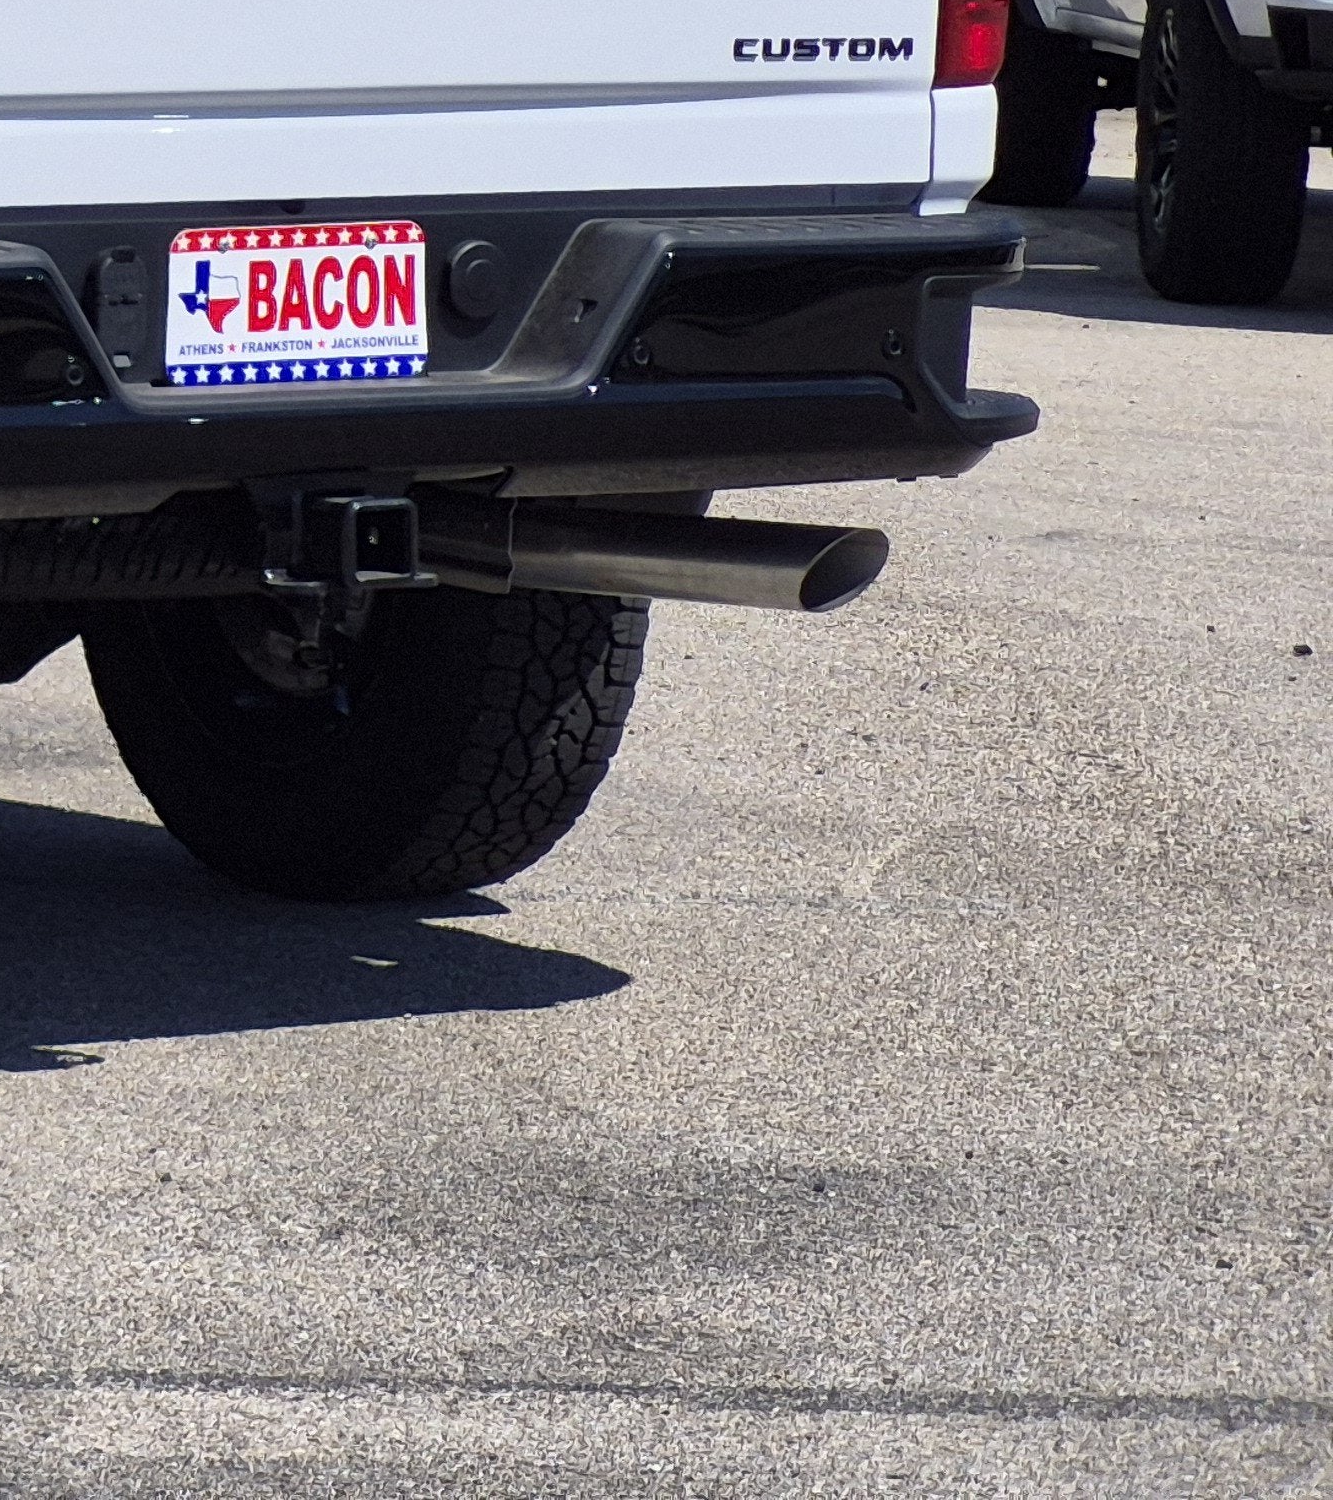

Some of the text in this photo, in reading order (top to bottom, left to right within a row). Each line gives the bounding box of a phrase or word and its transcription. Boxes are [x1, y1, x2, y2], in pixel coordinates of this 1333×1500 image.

[733, 37, 914, 62] CUSTOM
[247, 254, 416, 332] BACON
[178, 334, 419, 356] ATHENS FRANKSTON JACKSONVILLE
